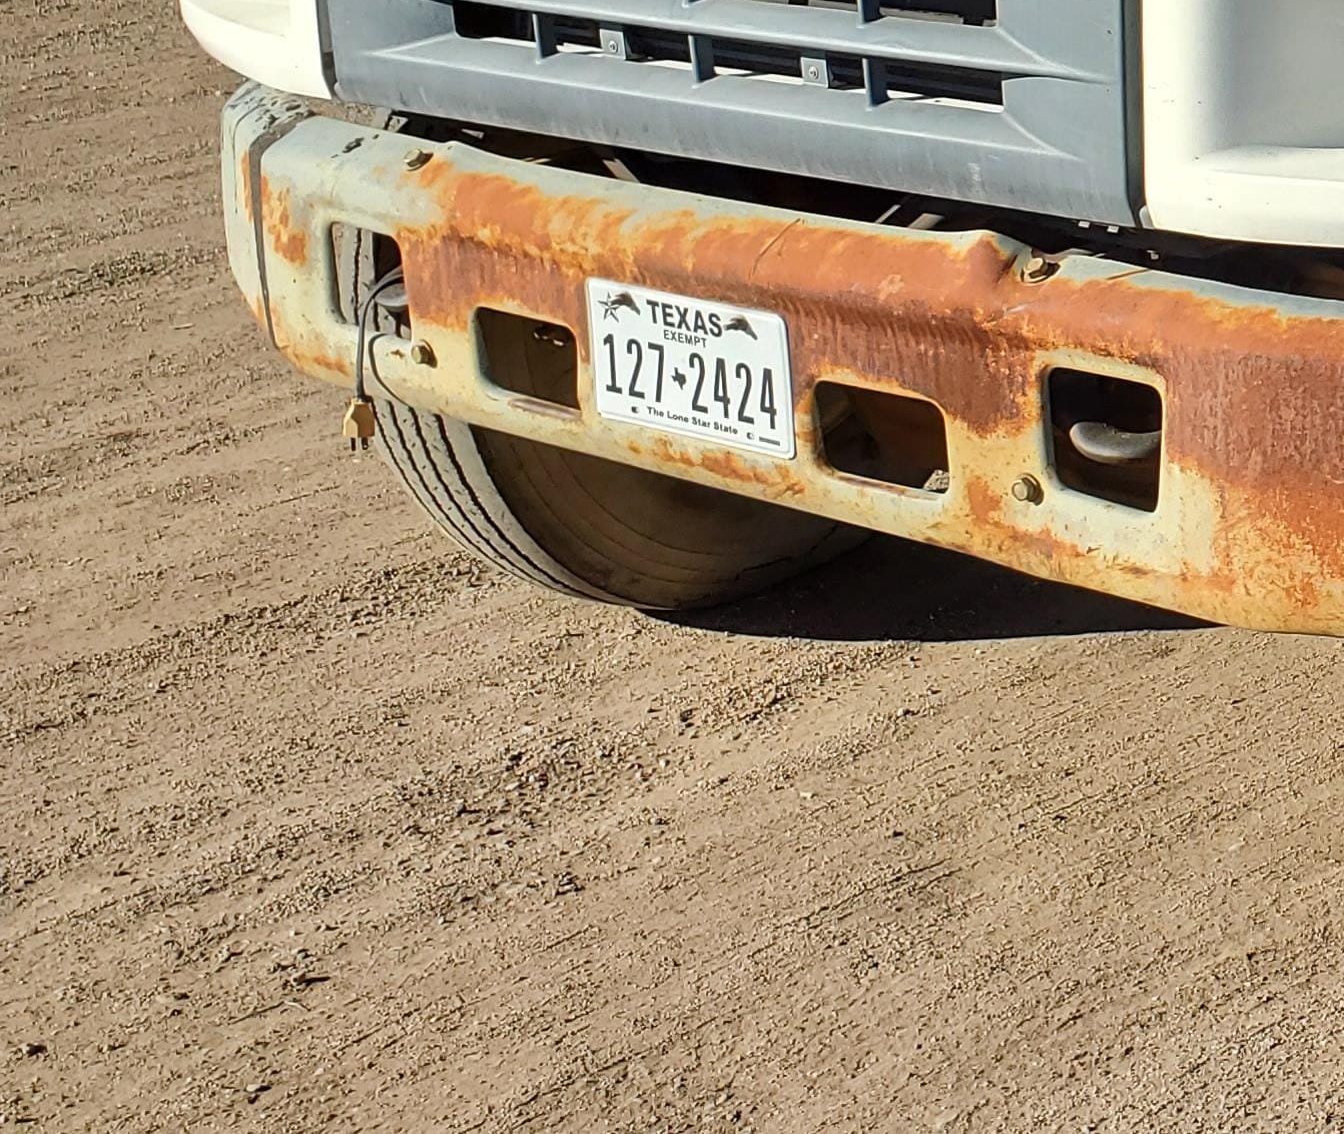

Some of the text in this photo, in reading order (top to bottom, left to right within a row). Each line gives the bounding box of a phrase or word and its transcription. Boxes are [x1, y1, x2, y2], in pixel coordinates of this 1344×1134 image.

[646, 298, 723, 338] TEXAS
[663, 329, 707, 348] EXEMPT
[646, 406, 738, 435] The Lone Star State
